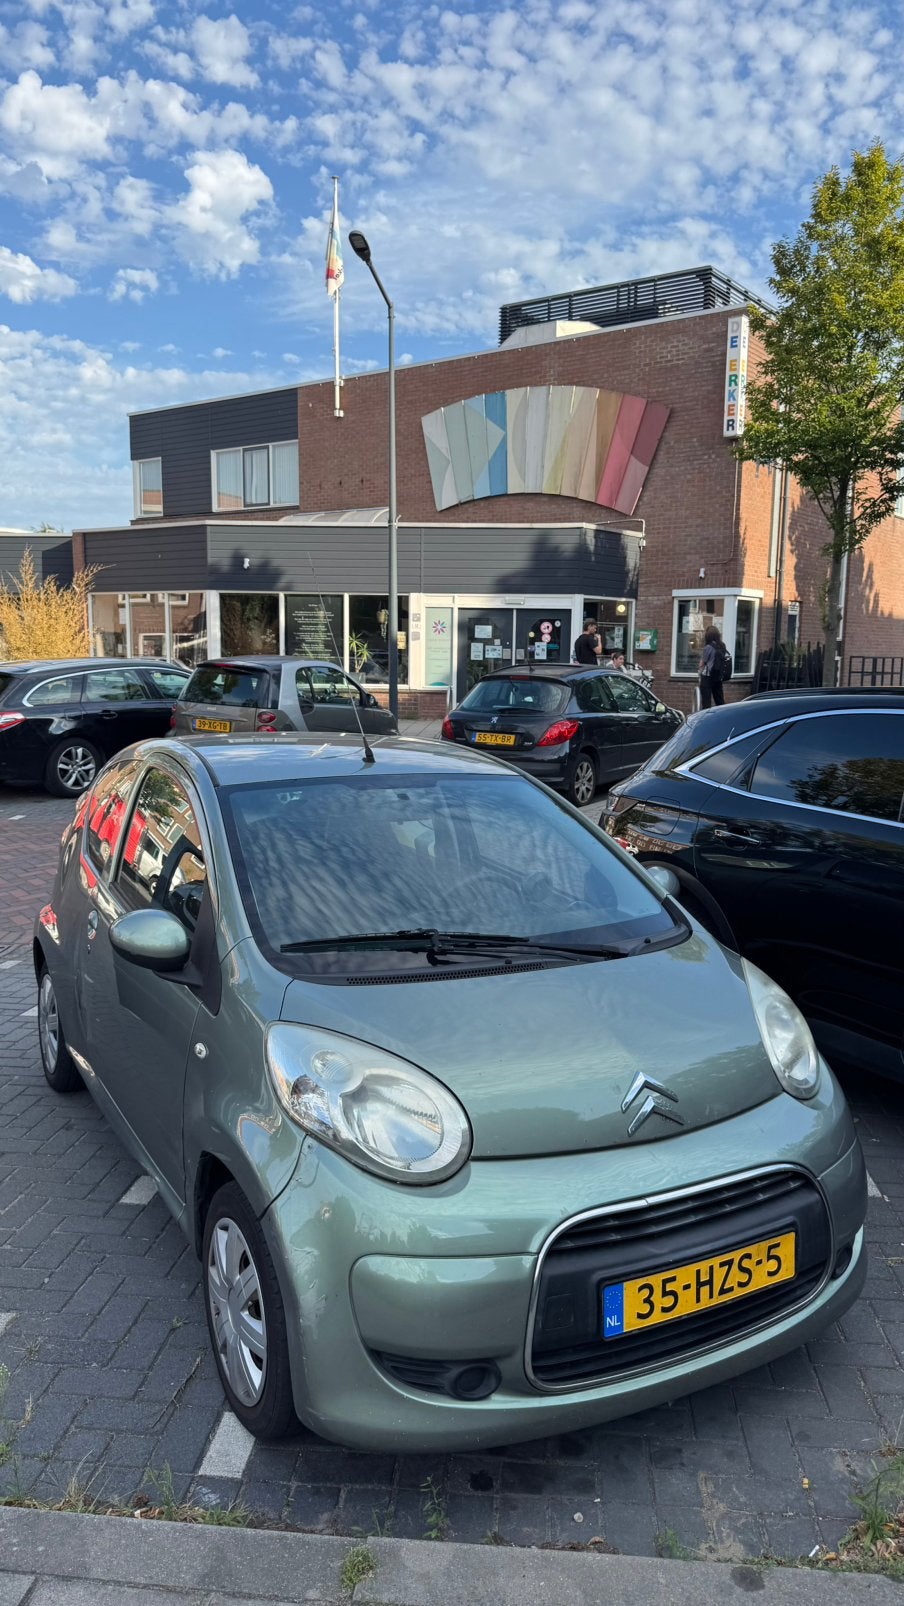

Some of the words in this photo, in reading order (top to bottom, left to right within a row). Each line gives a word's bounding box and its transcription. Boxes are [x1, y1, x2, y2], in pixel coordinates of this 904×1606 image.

[729, 320, 739, 349] DE
[726, 359, 739, 432] ERKER
[197, 720, 228, 731] 39-XG-TB
[477, 733, 512, 744] 55-TX-BR
[636, 1242, 782, 1320] 35-HZS-5
[606, 1314, 621, 1328] NL
